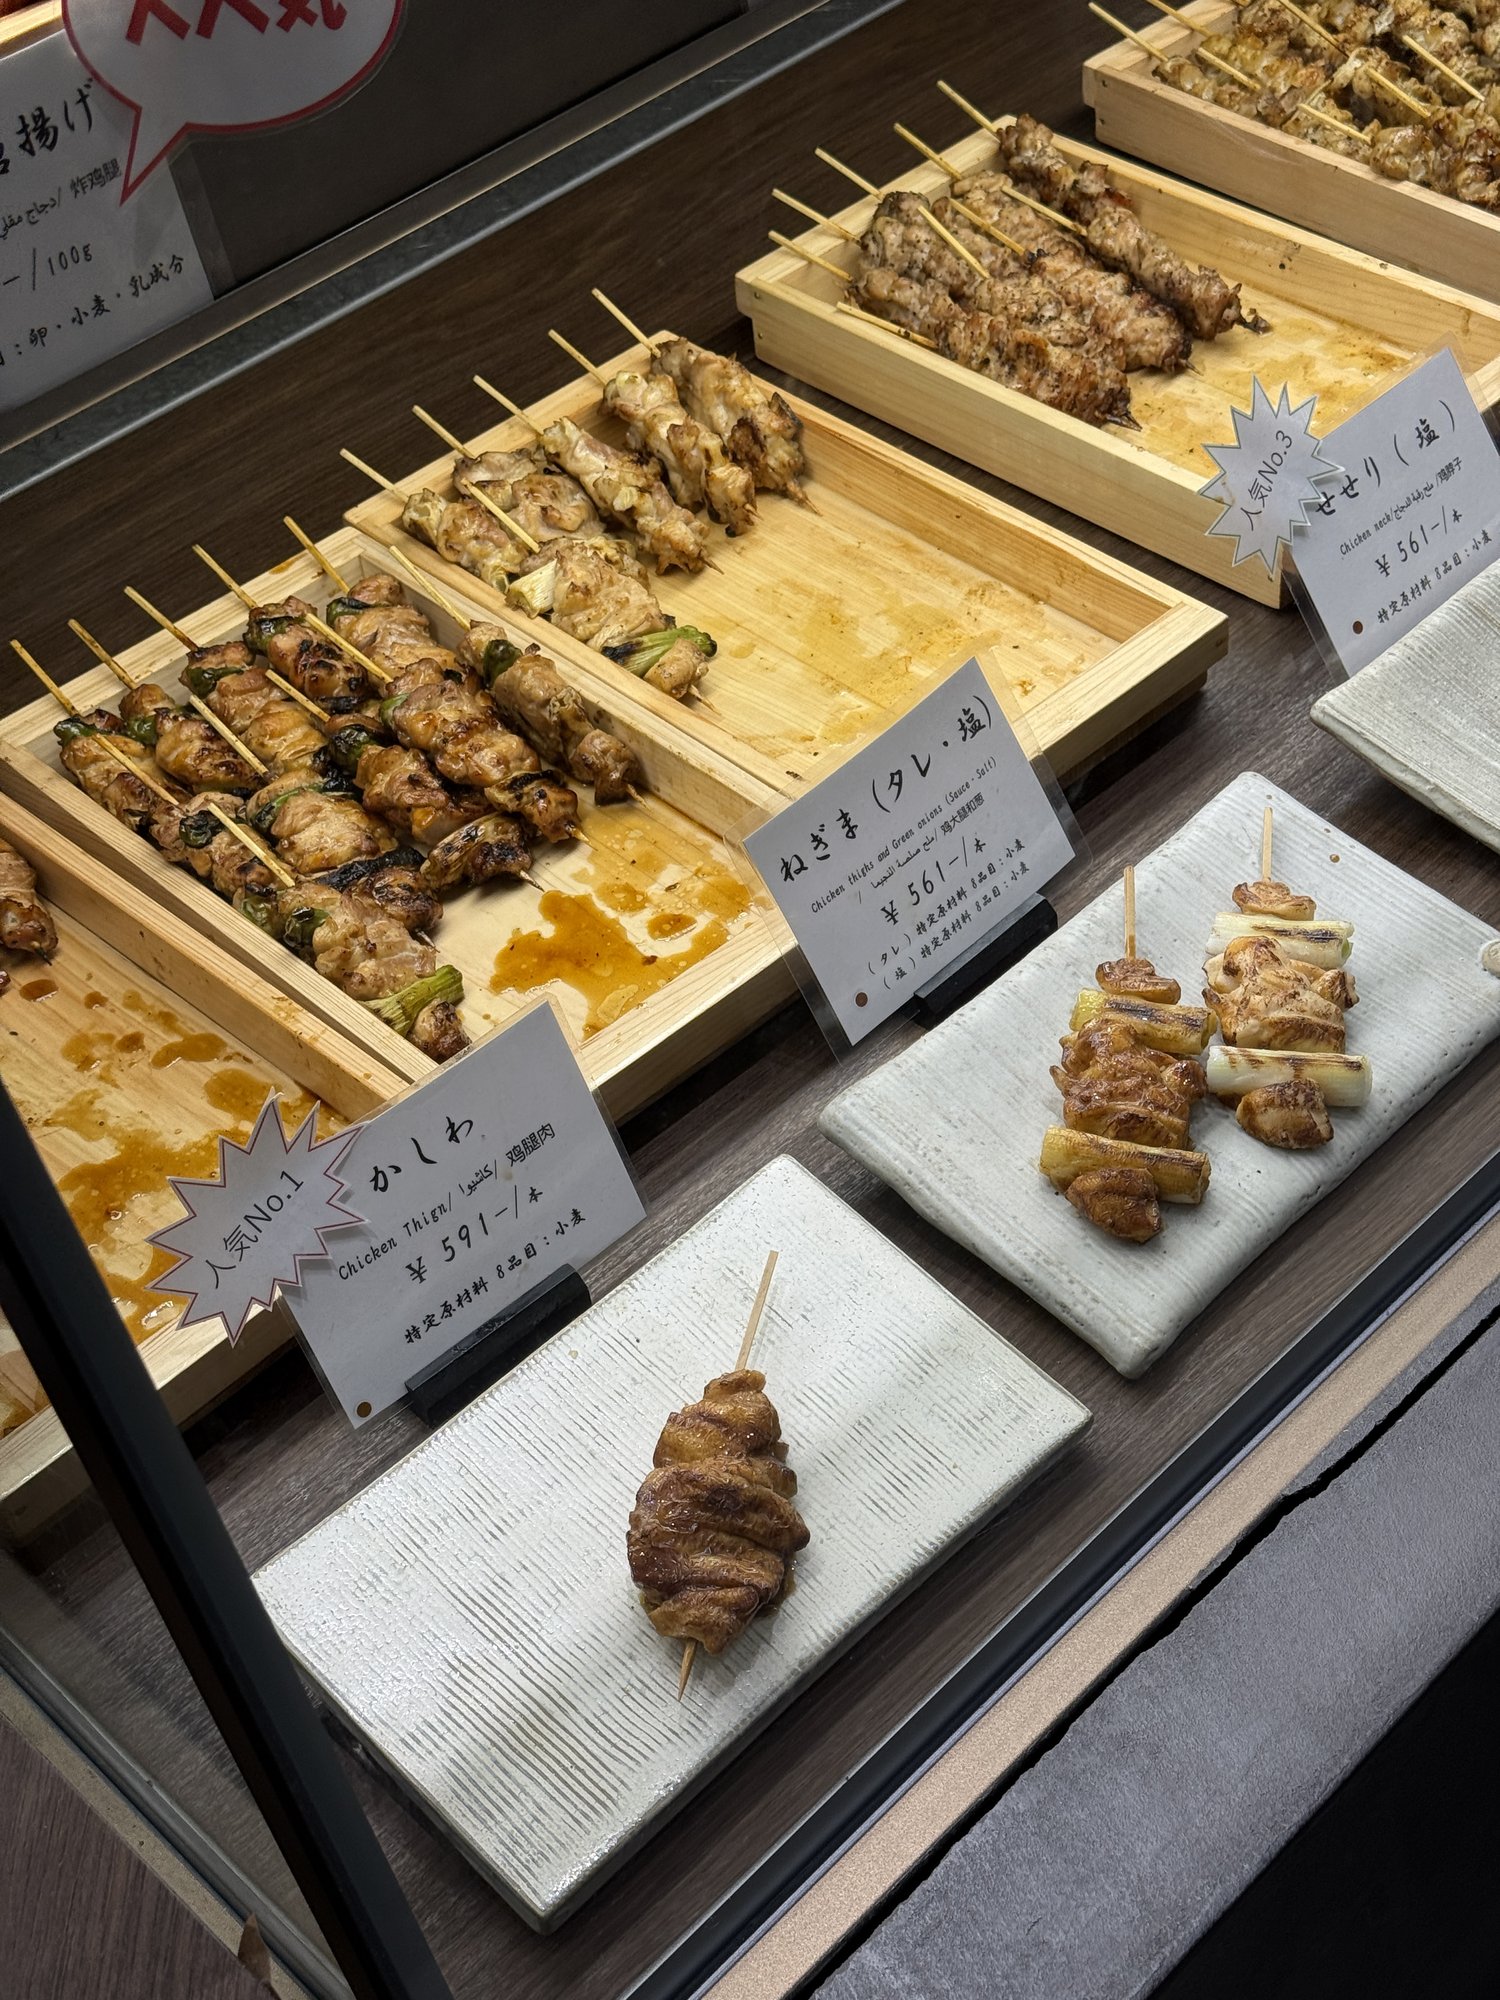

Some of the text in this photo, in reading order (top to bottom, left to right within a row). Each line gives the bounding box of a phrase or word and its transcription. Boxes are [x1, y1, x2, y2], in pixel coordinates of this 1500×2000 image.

[1240, 430, 1293, 531] 人気No.3
[1340, 529, 1372, 556] Chicken
[811, 884, 846, 913] Chicken
[848, 861, 875, 885] thighs
[877, 846, 891, 862] and
[892, 828, 915, 850] Green
[917, 805, 943, 830] onions
[338, 1237, 398, 1280] Chicken
[505, 1123, 556, 1167] 鸡腿肉
[369, 1116, 474, 1192] かしわ
[205, 1170, 304, 1289] 人気No.1
